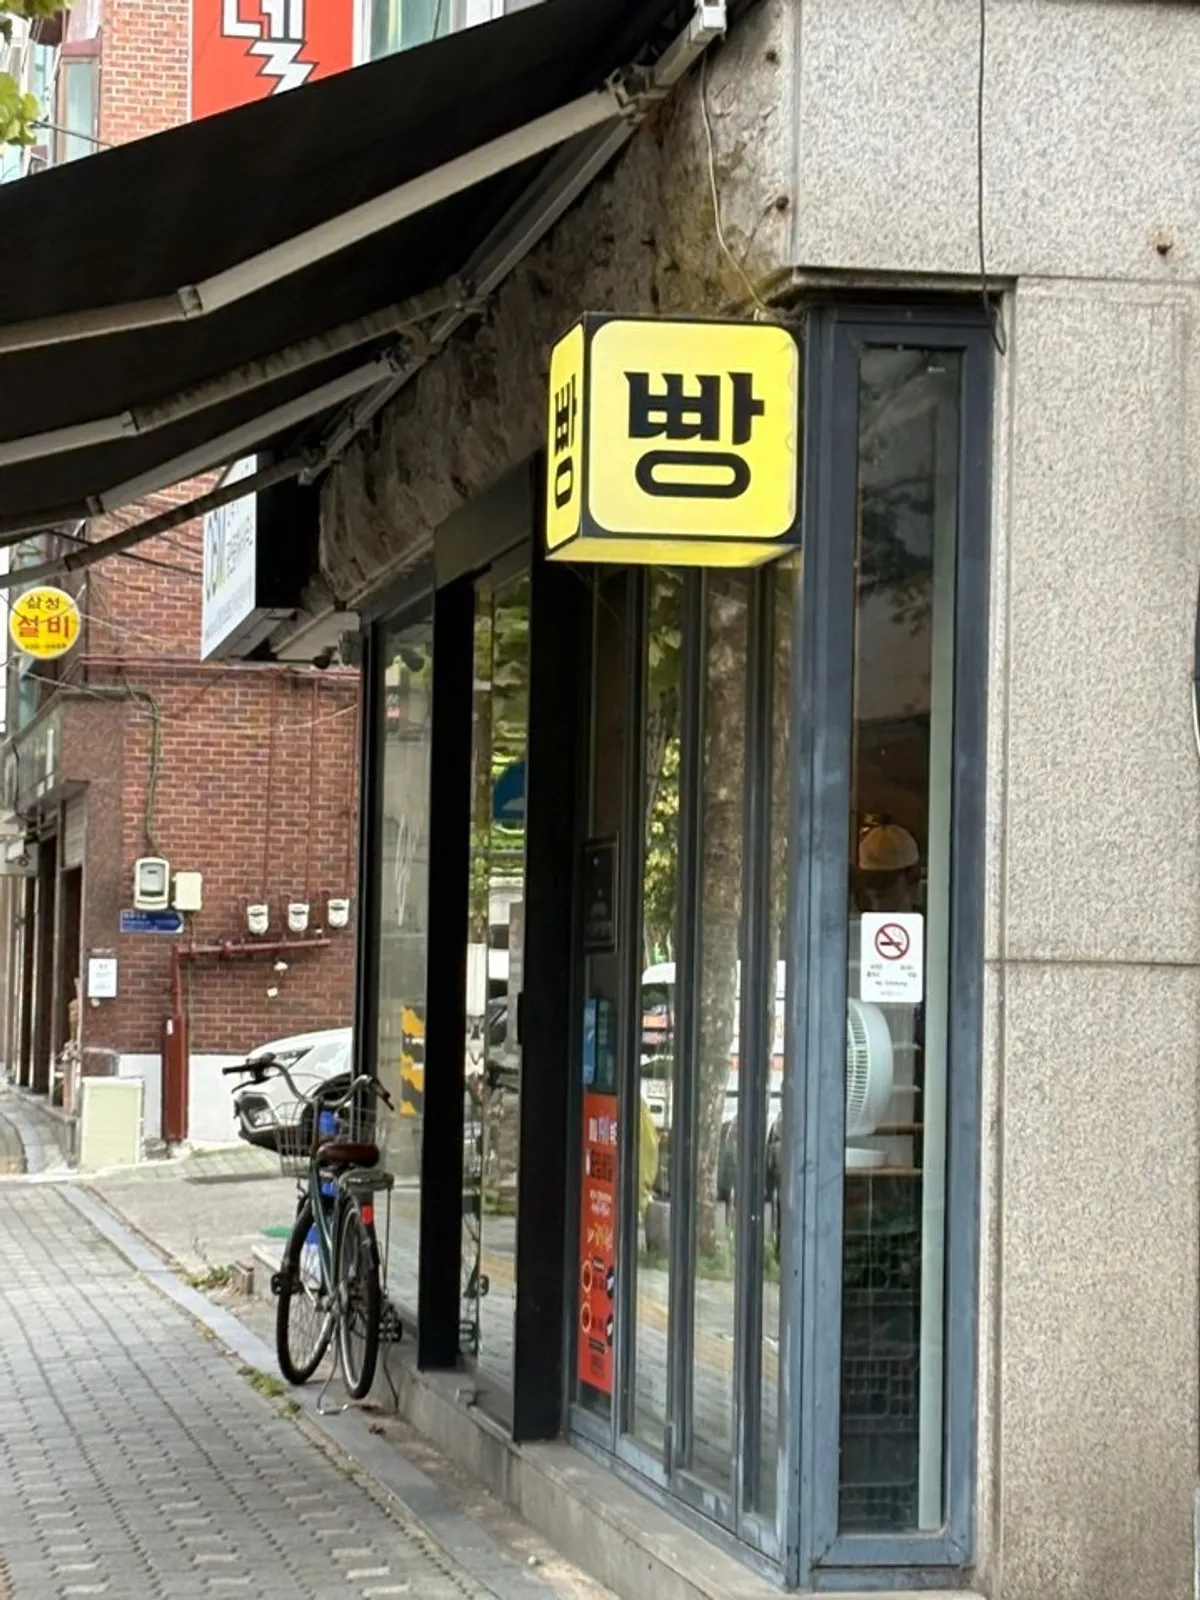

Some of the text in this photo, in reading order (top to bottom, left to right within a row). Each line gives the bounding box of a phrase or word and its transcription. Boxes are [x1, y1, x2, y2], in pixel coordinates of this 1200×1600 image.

[554, 373, 577, 510] 빵
[623, 371, 765, 500] 빵
[18, 615, 69, 638] 설비
